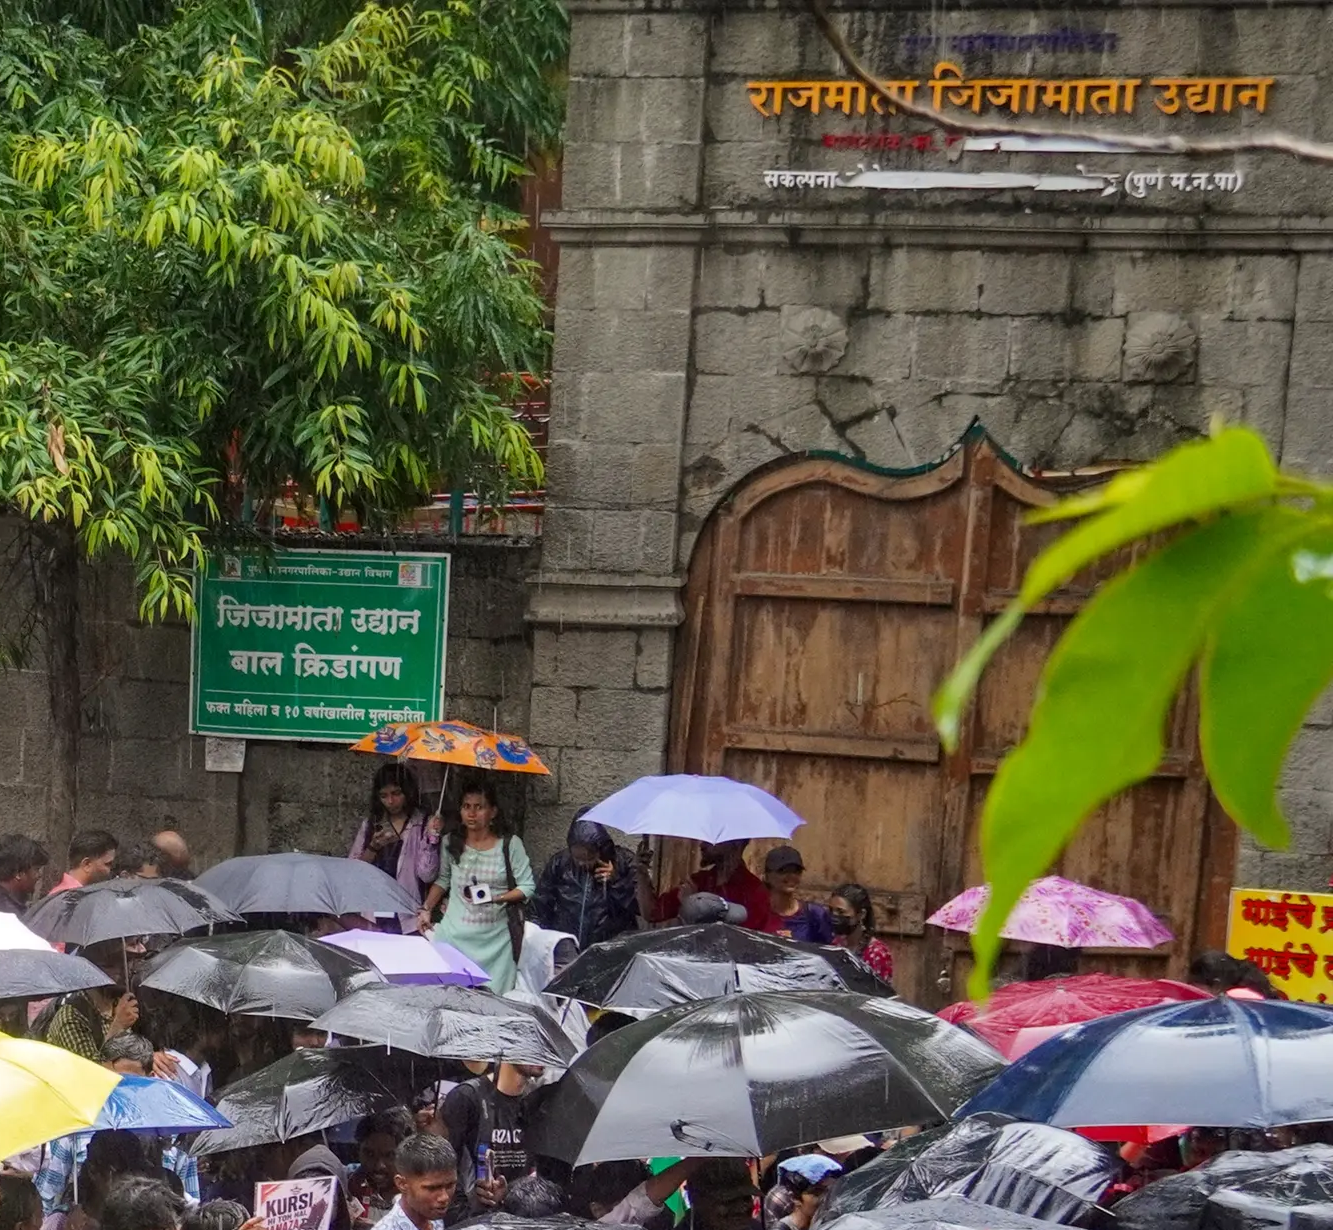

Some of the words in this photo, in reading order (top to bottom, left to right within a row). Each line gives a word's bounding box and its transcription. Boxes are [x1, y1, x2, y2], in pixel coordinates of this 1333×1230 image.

[928, 61, 1142, 114] जिजामाता
[1150, 76, 1275, 115] उद्यान
[216, 593, 343, 632] जिजामाता
[350, 607, 421, 635] उद्यान
[229, 649, 284, 676] बाल
[292, 642, 402, 680] क्रिडांगण
[205, 700, 231, 717] फक्त
[233, 698, 268, 718] महिला
[270, 705, 280, 717] व
[303, 702, 365, 721] वर्षाखालील
[368, 705, 426, 727] मुलांकरिता
[265, 1191, 314, 1218] KURSI
